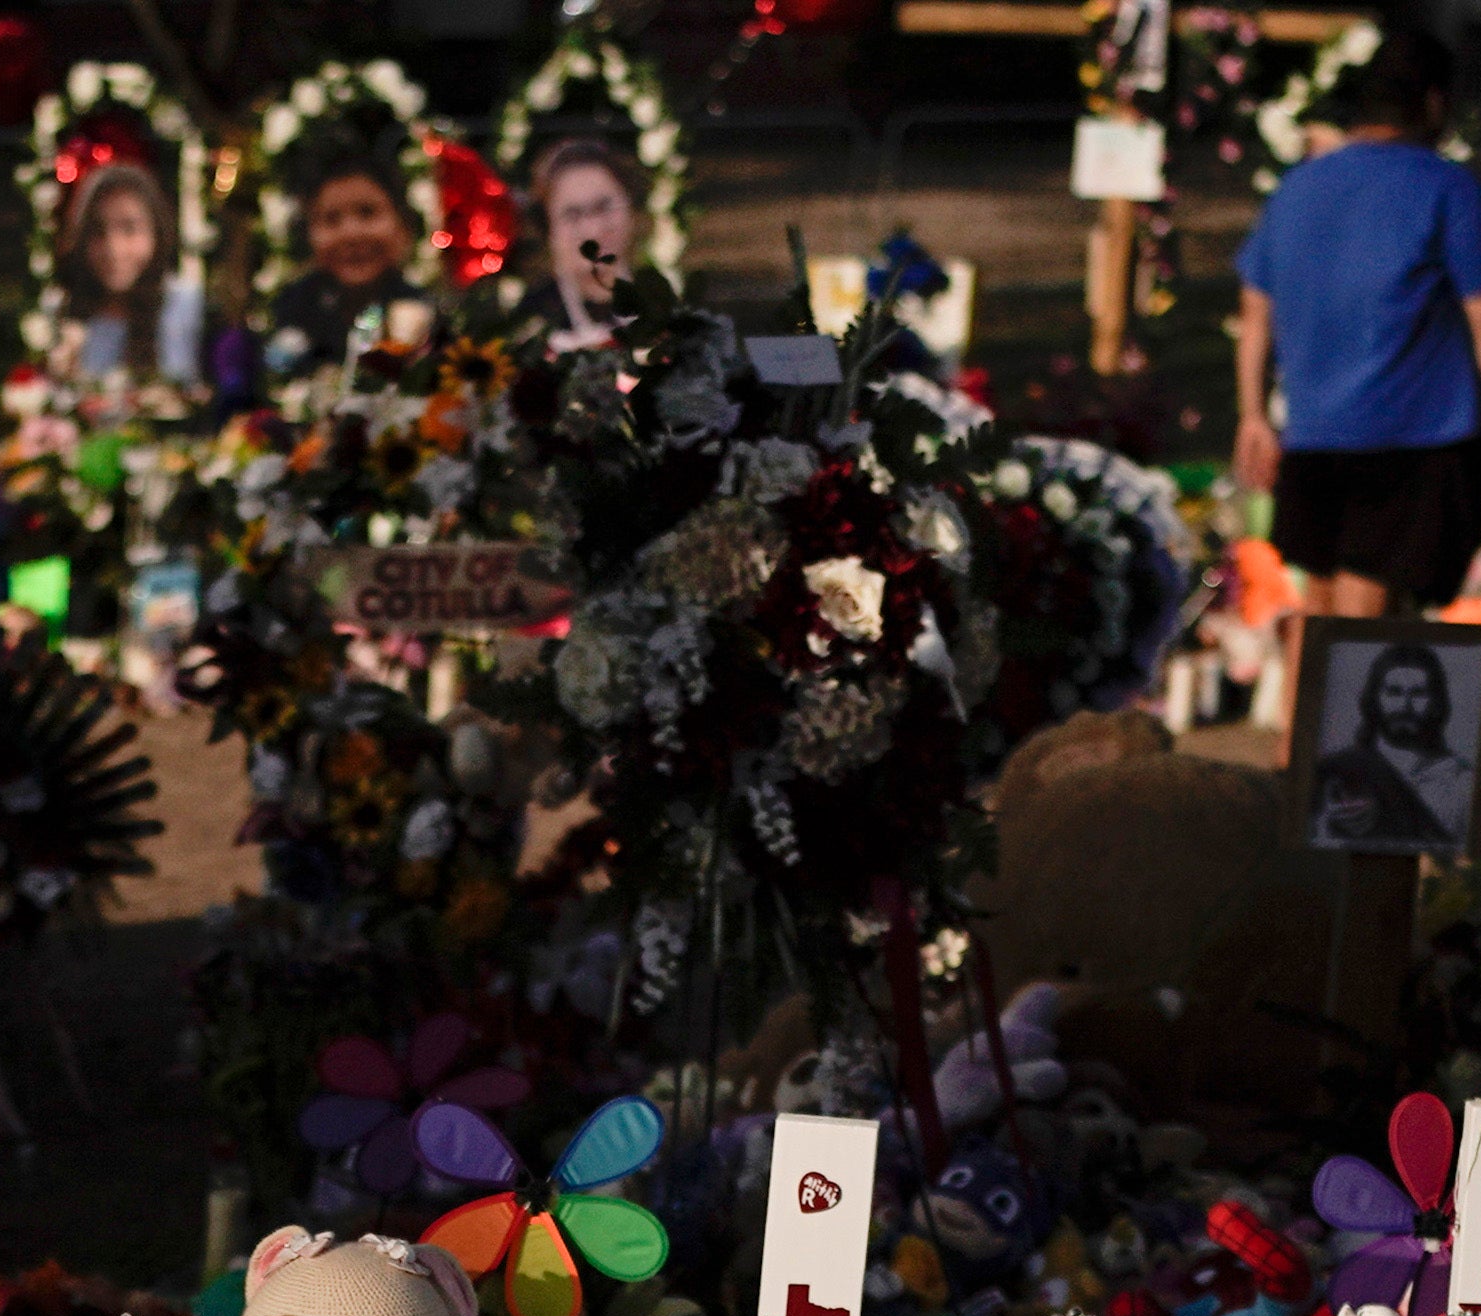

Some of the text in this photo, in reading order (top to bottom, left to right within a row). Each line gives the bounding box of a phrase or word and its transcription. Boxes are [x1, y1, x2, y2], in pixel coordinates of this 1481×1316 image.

[373, 553, 515, 584] CITY OF
[356, 586, 532, 619] COTULLA
